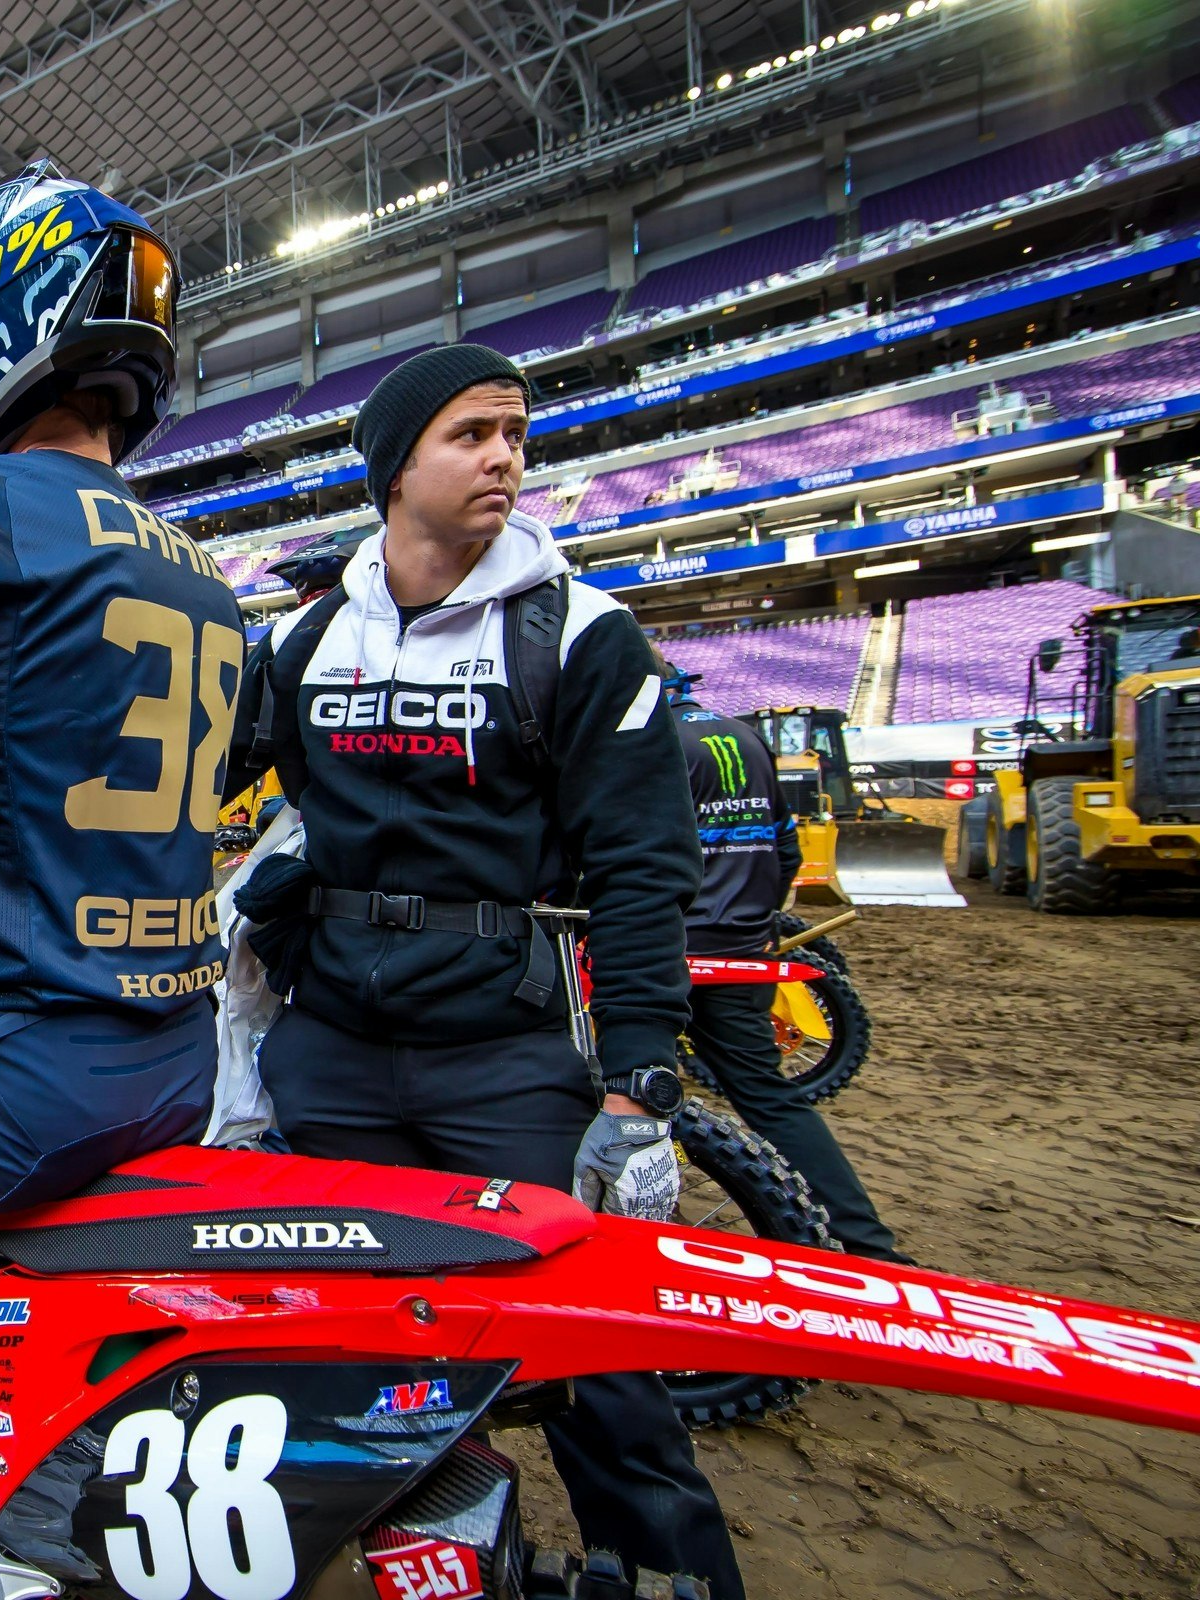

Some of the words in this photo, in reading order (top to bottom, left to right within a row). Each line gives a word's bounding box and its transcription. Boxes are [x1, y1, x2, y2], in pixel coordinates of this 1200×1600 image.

[647, 384, 682, 401] YAMAHA
[299, 476, 323, 487] YAMAHA
[812, 469, 853, 483] YAMAHA
[167, 508, 189, 518] YAMAHA
[586, 515, 620, 529] YAMAHA
[924, 505, 997, 530] YAMAHA
[653, 555, 707, 574] YAMAHA
[261, 578, 284, 588] YAMAHA
[64, 597, 244, 833] 38
[309, 691, 487, 729] GEICO
[329, 734, 467, 756] HONDA
[700, 798, 771, 814] MONSTER
[117, 960, 224, 998] HONDA
[630, 1148, 675, 1192] Mechanix
[192, 1222, 384, 1250] HONDA
[725, 1296, 1064, 1377] YOSHIMURA
[0, 1390, 14, 1402] Air
[363, 1378, 453, 1417] AMA
[103, 1394, 296, 1600] 38
